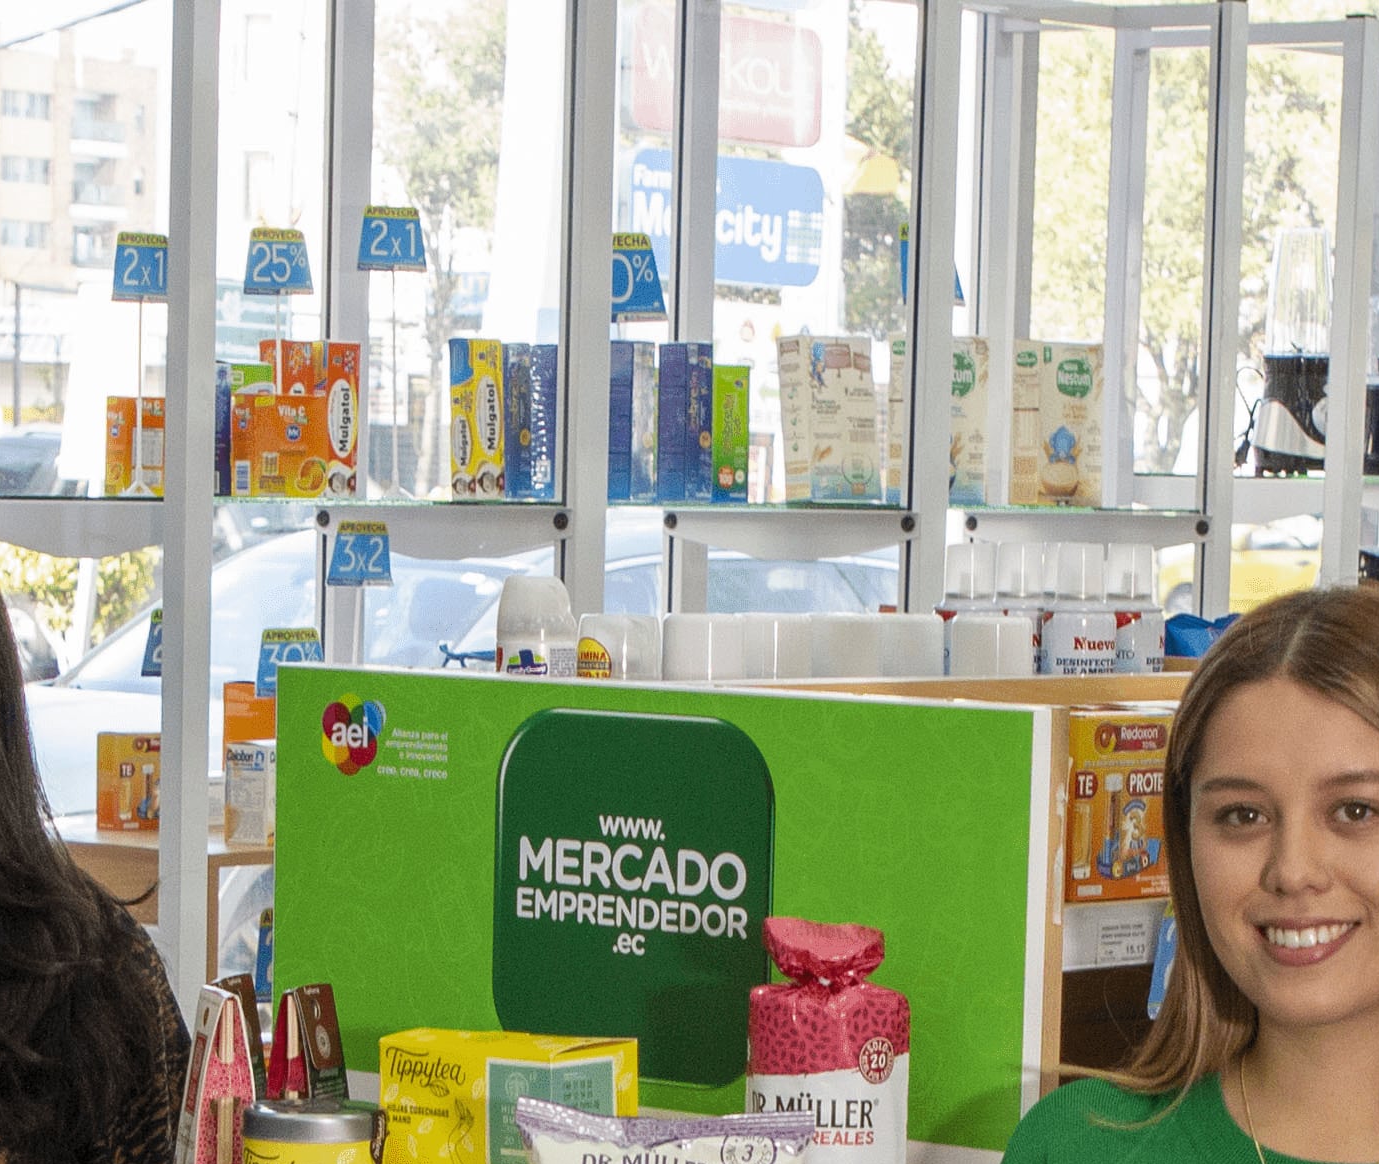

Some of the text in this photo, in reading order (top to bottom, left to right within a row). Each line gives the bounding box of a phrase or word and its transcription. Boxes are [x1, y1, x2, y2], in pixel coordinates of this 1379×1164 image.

[367, 208, 419, 217] APROVECHA
[252, 230, 303, 240] APROVECHA
[371, 220, 416, 257] 2x1
[252, 243, 307, 282] 25%
[340, 387, 351, 452] Mulgatol
[487, 383, 499, 451] Mulgatol
[460, 419, 468, 467] Mulgatol
[340, 523, 386, 532] APROVECHA
[339, 536, 383, 573] 3x2
[265, 630, 318, 641] APROVECHA
[1074, 636, 1115, 650] Nuevo
[331, 716, 369, 748] aei
[1121, 726, 1158, 740] Redoxon
[1078, 774, 1094, 795] TE
[599, 814, 666, 841] www.
[519, 835, 747, 901] MERCADO
[516, 886, 748, 940] EMPRENDEDOR
[612, 932, 646, 956] .ec
[385, 1046, 466, 1088] Tippytea
[870, 1054, 886, 1069] 20
[742, 1145, 753, 1161] 3
